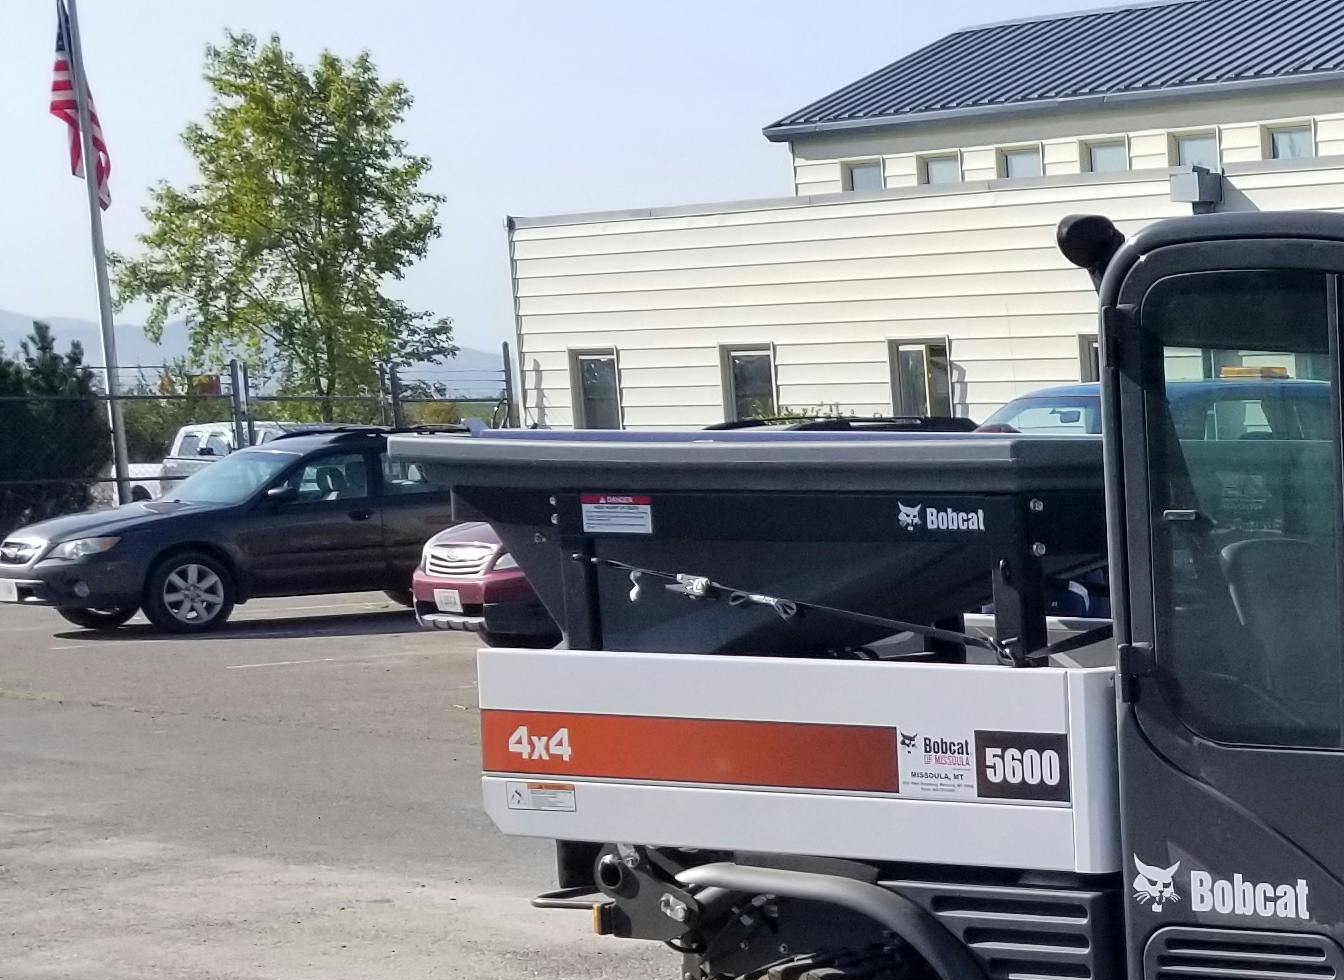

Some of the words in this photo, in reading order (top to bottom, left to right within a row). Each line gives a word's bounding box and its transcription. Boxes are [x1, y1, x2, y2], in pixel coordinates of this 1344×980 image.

[926, 507, 985, 531] Bobcat
[508, 725, 572, 762] 4x4
[923, 736, 970, 756] Bobcat
[934, 755, 970, 767] MISSOULA
[985, 747, 1061, 786] 5600
[1190, 870, 1310, 920] Bobcat
